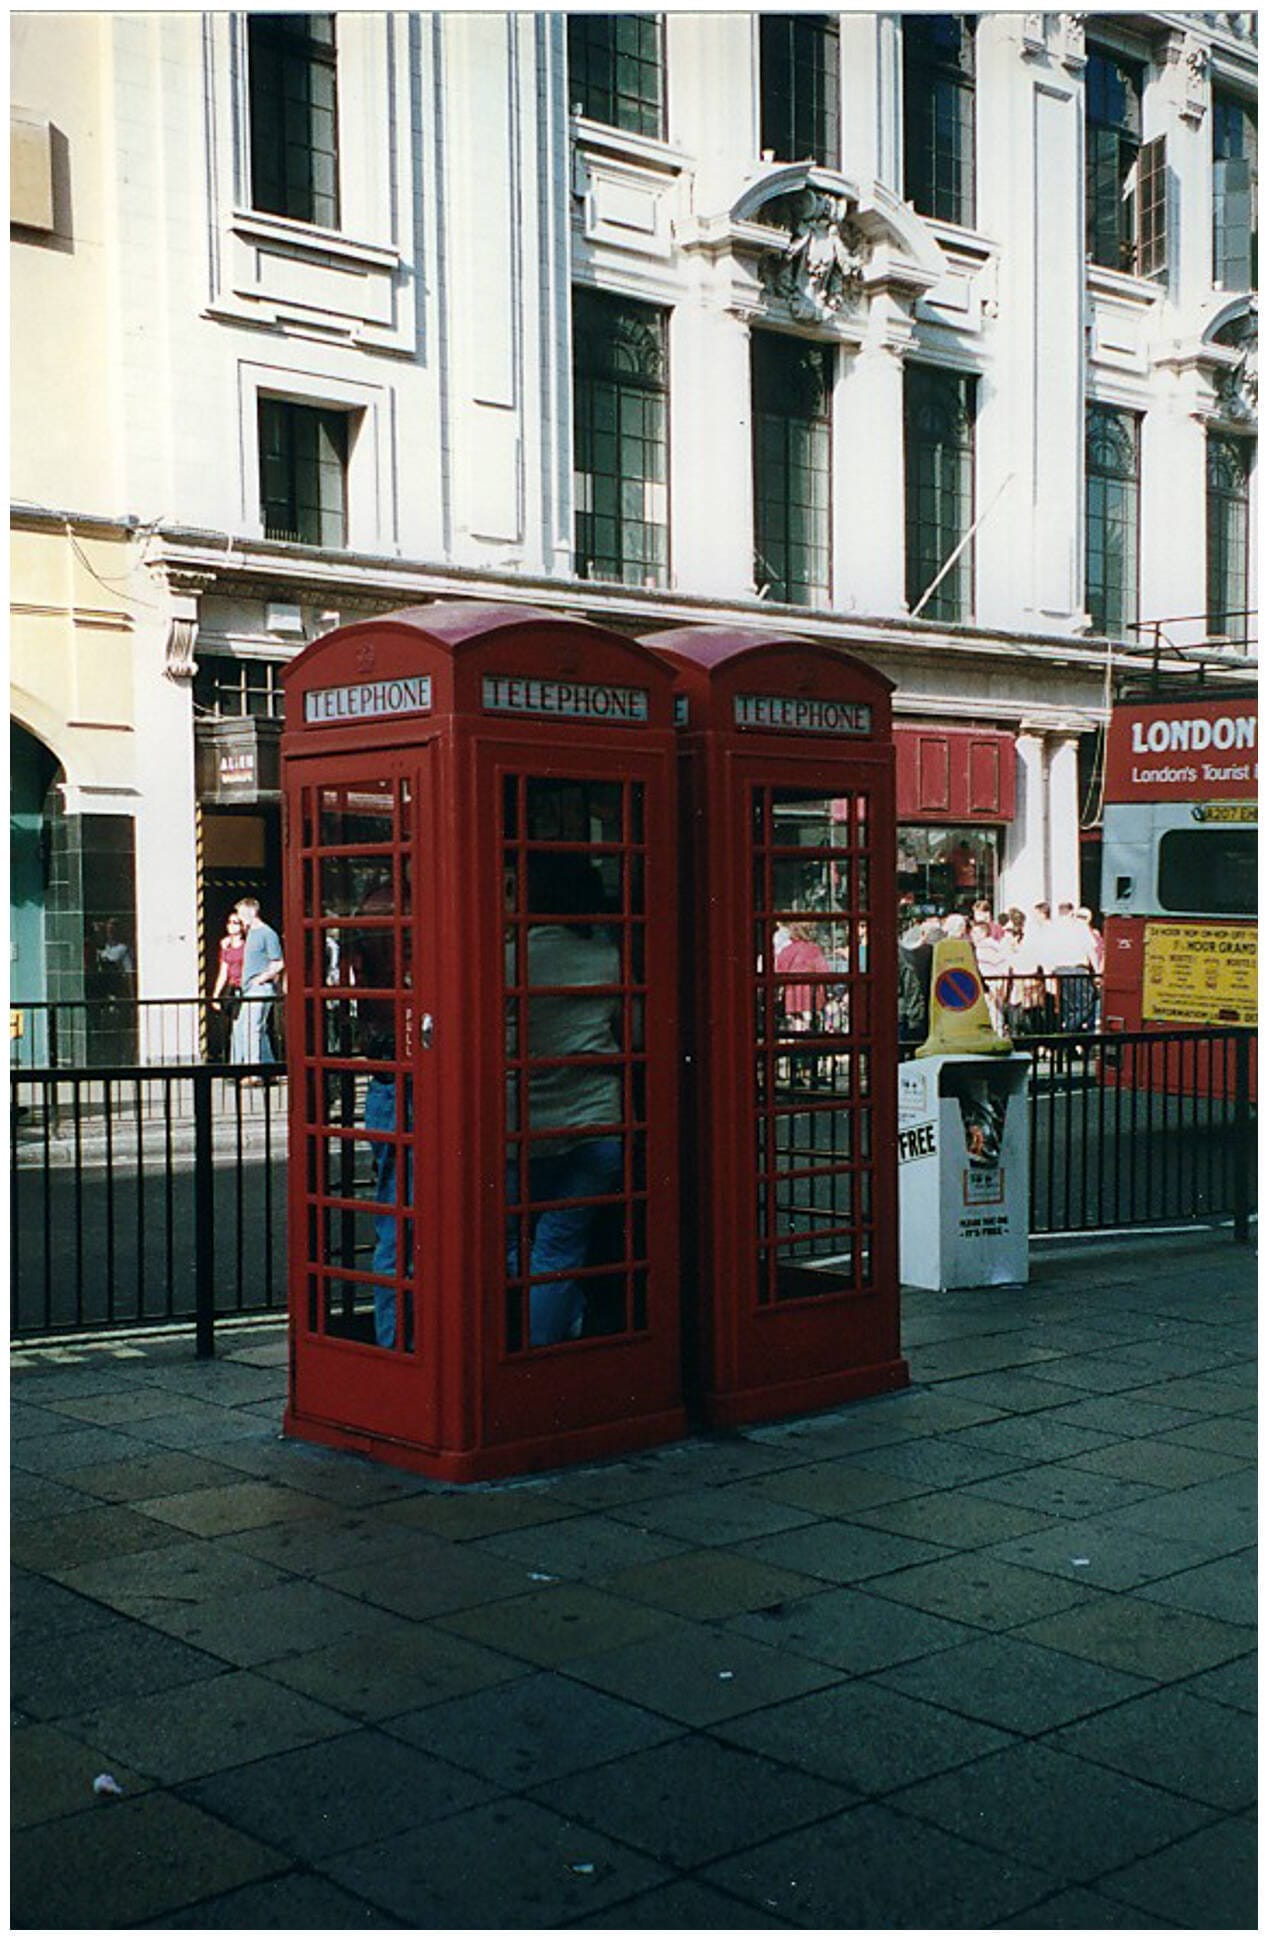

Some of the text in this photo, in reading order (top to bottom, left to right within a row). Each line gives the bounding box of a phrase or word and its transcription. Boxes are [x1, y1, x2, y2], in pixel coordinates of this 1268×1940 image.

[310, 679, 429, 718] TELEPHONE
[487, 678, 642, 717] TELEPHONE
[736, 696, 866, 730] TELEPHONE
[1131, 716, 1258, 754] LONDON
[1132, 765, 1198, 783] London's
[1202, 763, 1249, 780] Tourist
[899, 1125, 936, 1160] FREE
